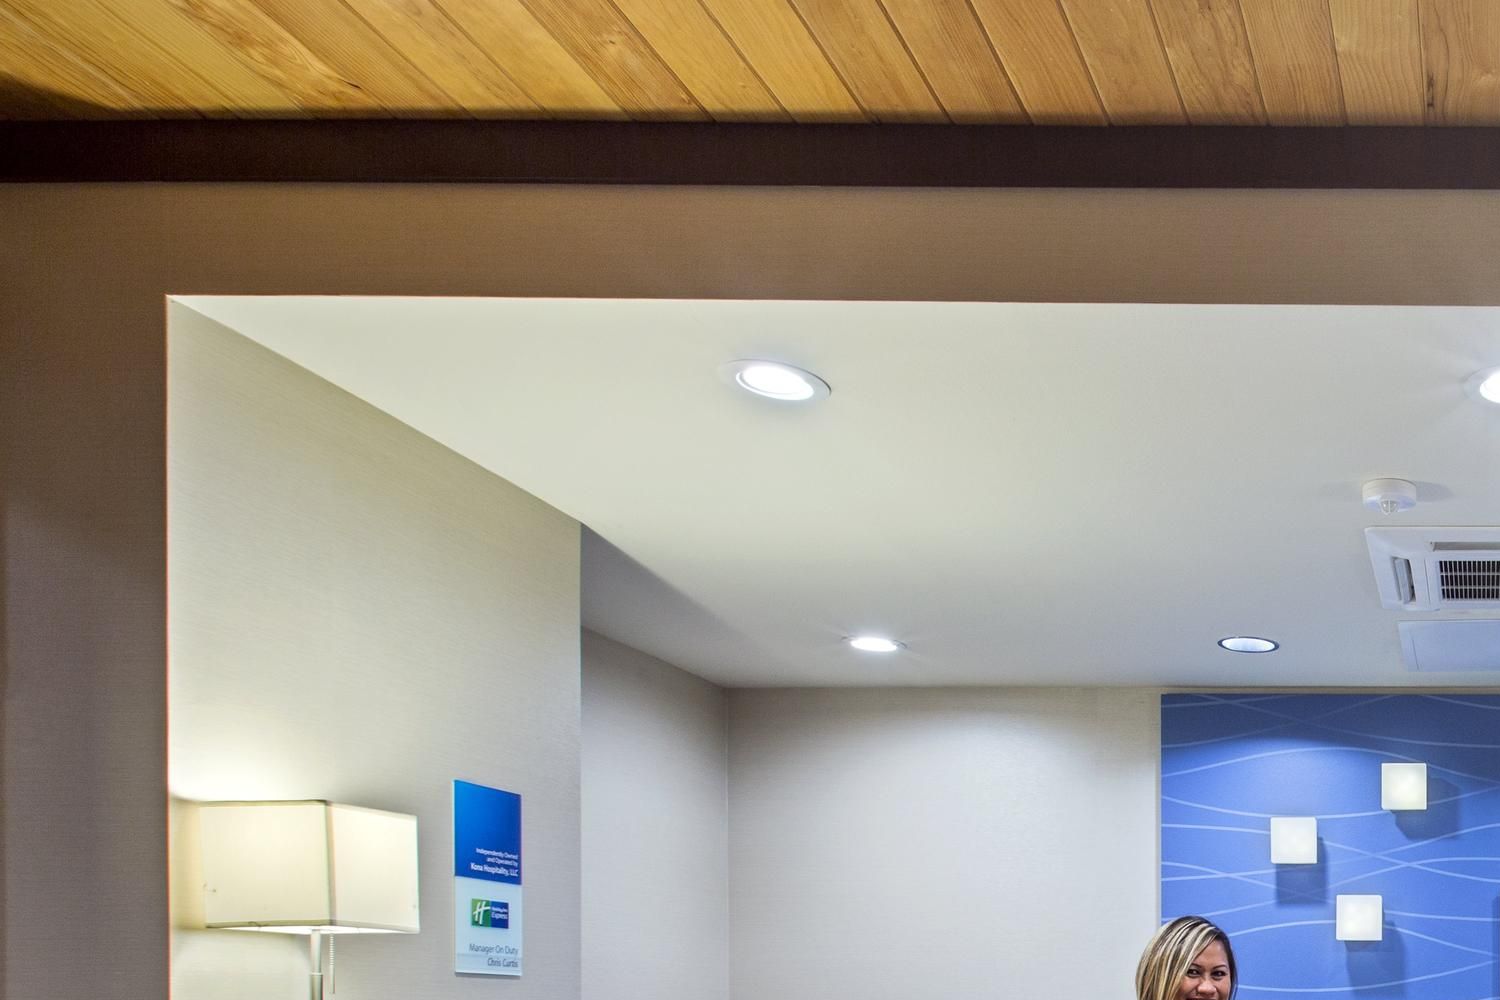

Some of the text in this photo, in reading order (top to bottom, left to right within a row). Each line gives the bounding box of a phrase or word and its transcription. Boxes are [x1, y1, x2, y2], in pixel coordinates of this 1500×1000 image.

[469, 944, 518, 956] Manager On Duty
